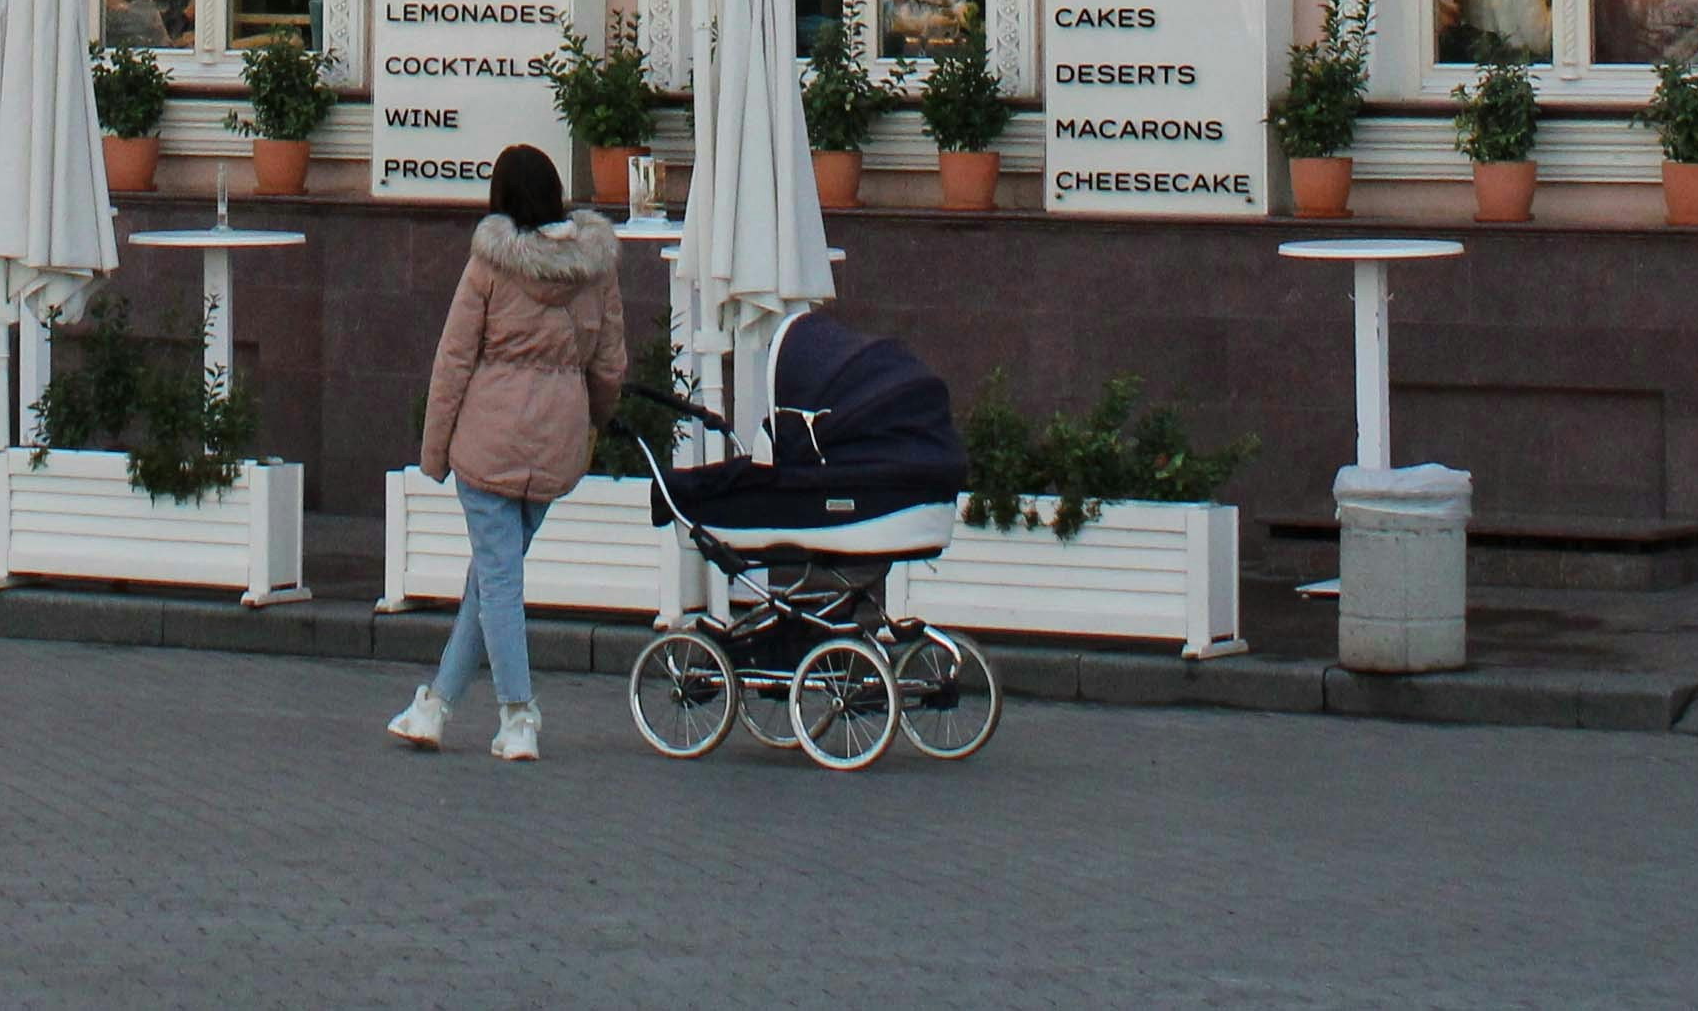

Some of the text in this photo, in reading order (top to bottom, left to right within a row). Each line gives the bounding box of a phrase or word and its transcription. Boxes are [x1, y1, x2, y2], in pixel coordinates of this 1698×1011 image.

[386, 3, 556, 23] LEMONADES
[1055, 8, 1156, 28] CAKES
[385, 57, 545, 77] COCKTAILS
[1055, 64, 1195, 85] DESERTS
[385, 108, 459, 128] WINE
[1055, 119, 1223, 140] MACARONS
[384, 159, 493, 180] PROSEC
[1055, 171, 1250, 193] CHEESECAKE
